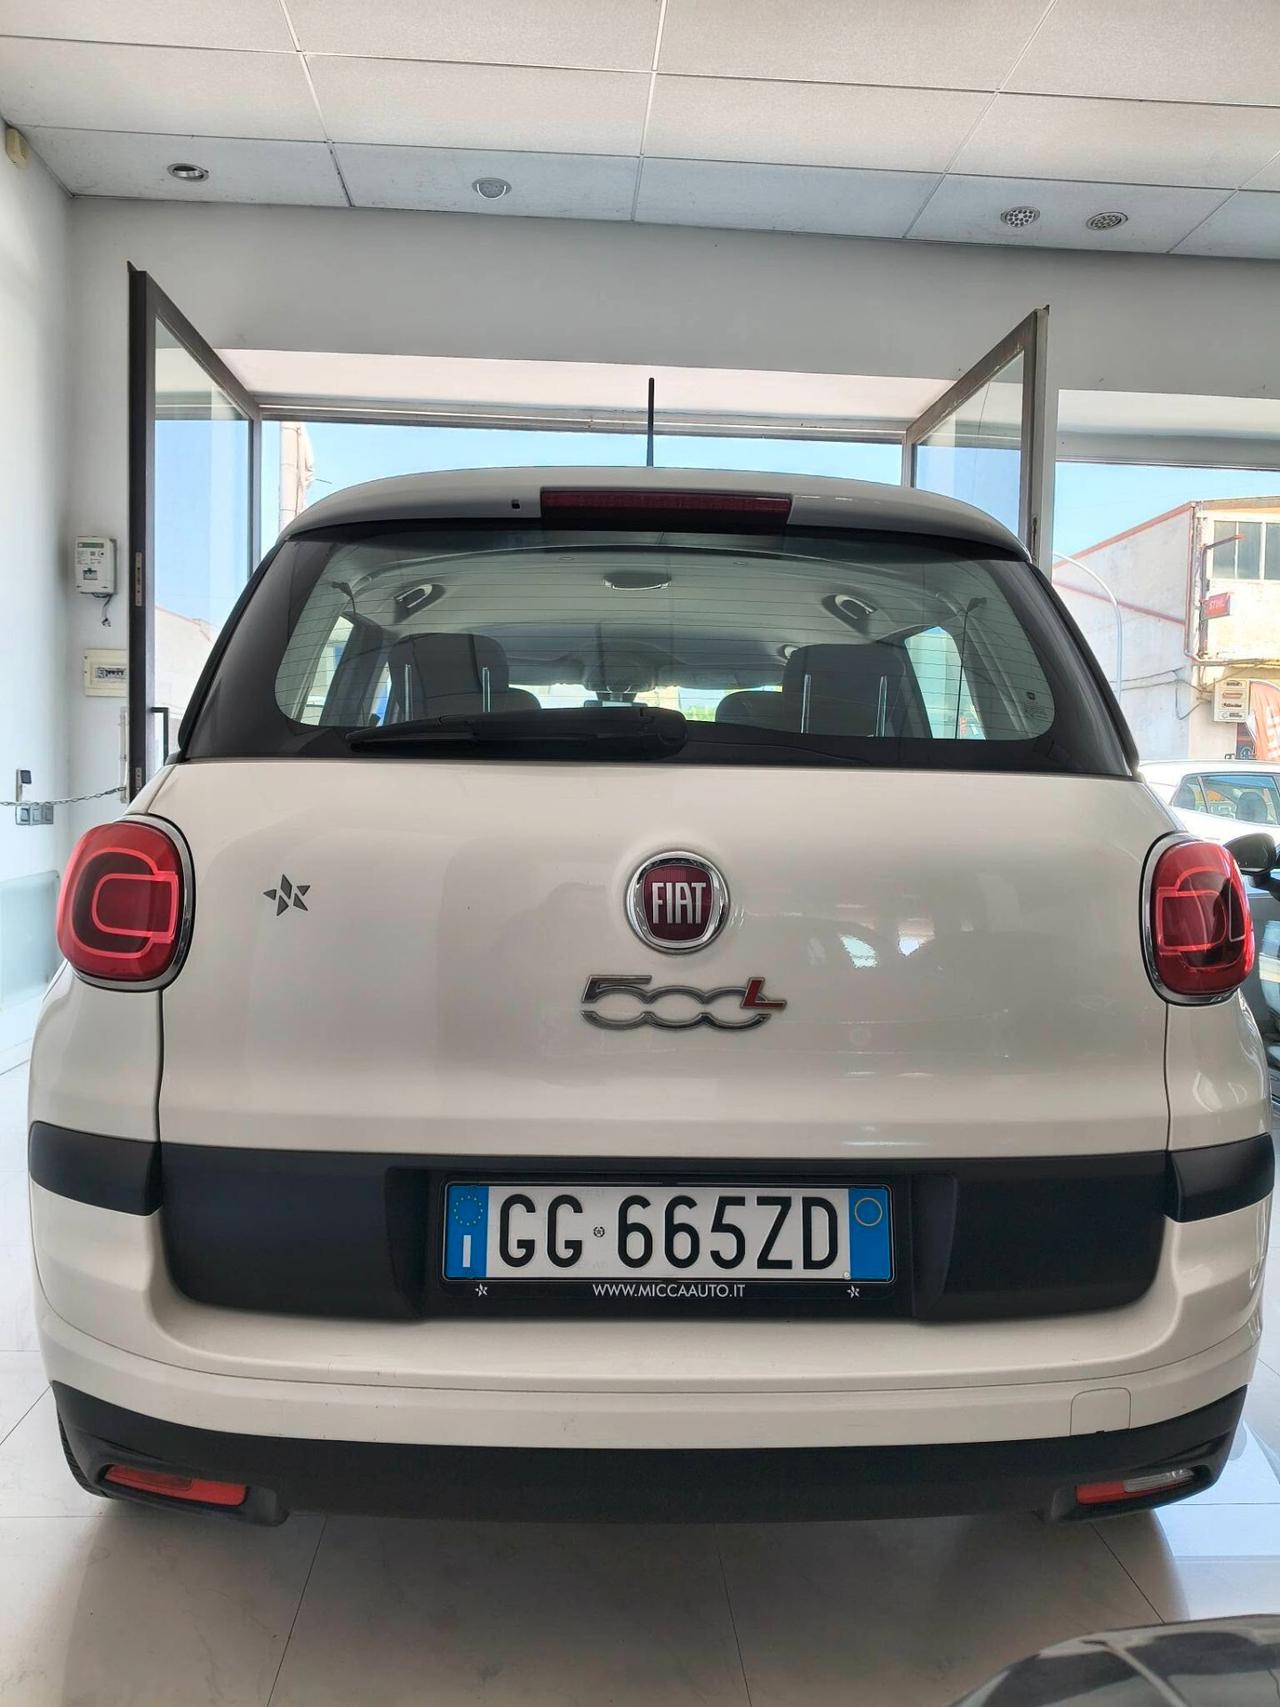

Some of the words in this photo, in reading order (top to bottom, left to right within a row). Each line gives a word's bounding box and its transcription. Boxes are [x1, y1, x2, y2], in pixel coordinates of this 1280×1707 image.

[651, 882, 707, 924] FIAT
[499, 1193, 584, 1268] GG
[617, 1194, 839, 1271] 665ZD
[592, 1283, 746, 1297] WWW.MICCAAUTO.IT
